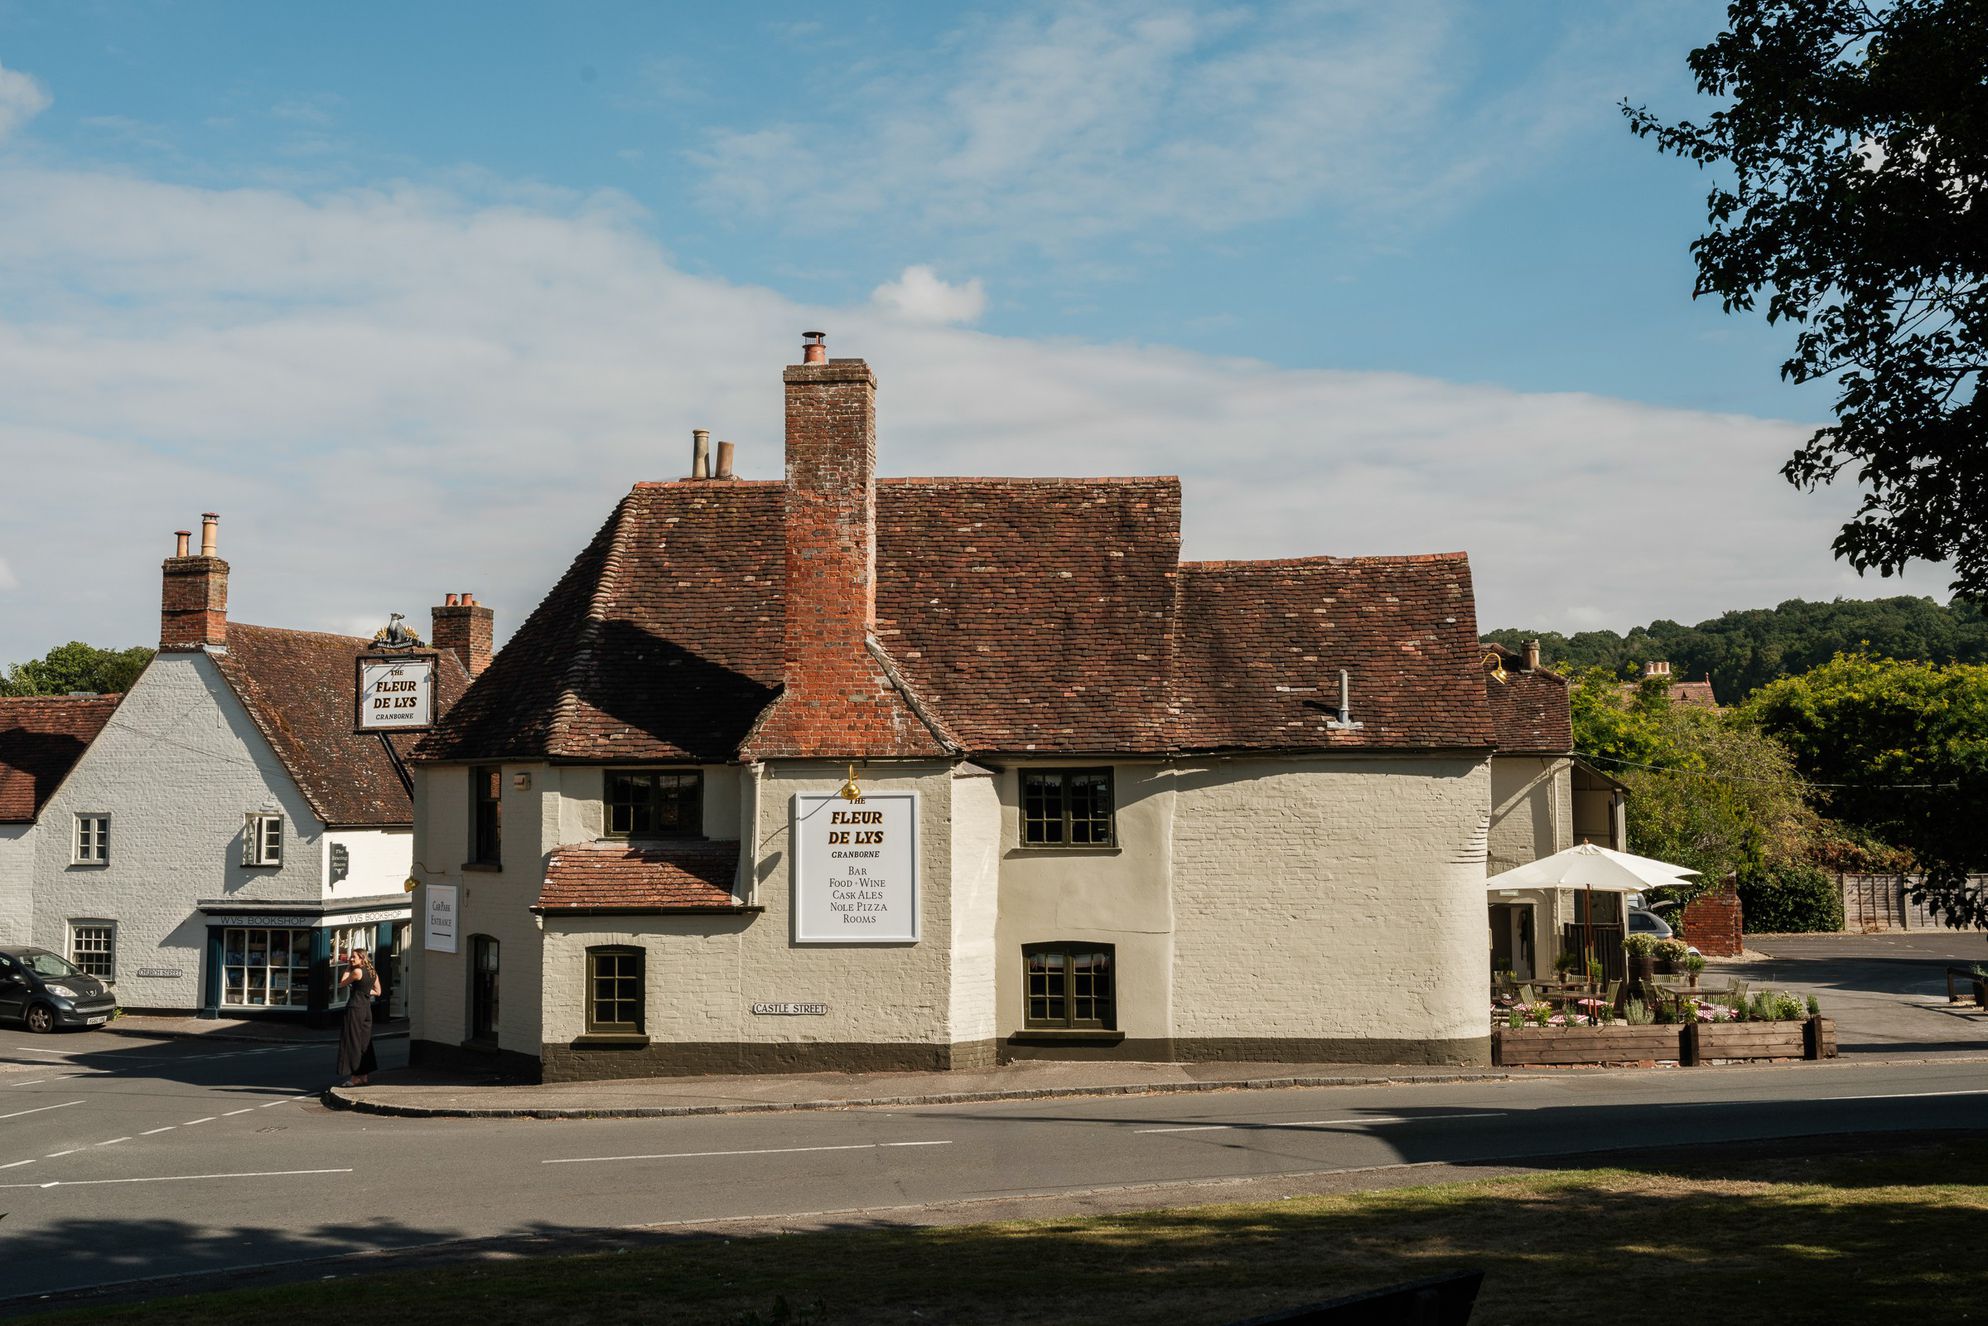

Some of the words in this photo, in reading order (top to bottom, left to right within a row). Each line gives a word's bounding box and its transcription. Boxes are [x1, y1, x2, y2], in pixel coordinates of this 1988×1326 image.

[376, 681, 417, 692] FLEUR
[374, 698, 391, 709] DE
[394, 697, 417, 708] LYS
[831, 811, 883, 824] FLEUR
[828, 831, 850, 844] DE
[854, 830, 884, 844] LYS
[848, 866, 868, 876] BAR
[829, 878, 853, 888] FOOD
[859, 878, 886, 888] WINE
[832, 890, 856, 899] CASK
[857, 890, 883, 899] ALES
[857, 902, 888, 911] PIZZA
[247, 916, 306, 925] BOOKSHOP
[365, 910, 401, 921] BOOKSHOP
[843, 914, 876, 923] ROOMS
[755, 1004, 789, 1013] CASTLE
[793, 1004, 825, 1013] STREET
